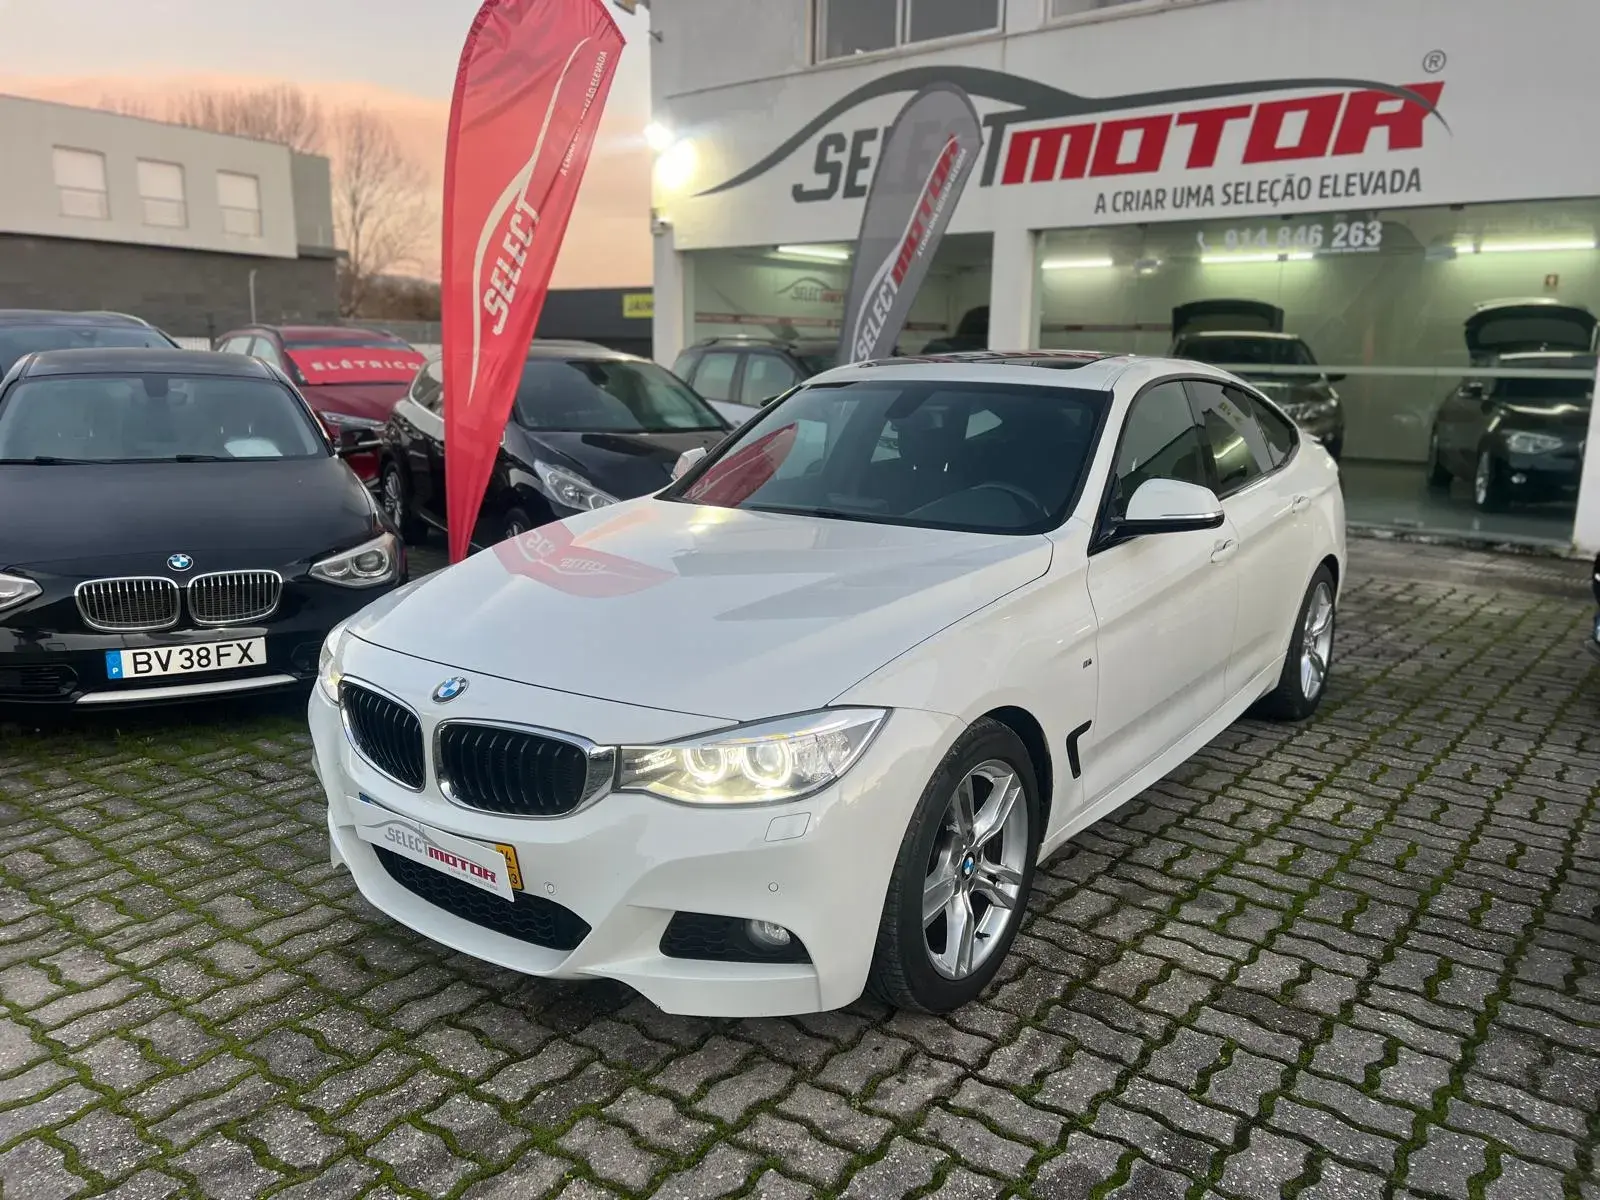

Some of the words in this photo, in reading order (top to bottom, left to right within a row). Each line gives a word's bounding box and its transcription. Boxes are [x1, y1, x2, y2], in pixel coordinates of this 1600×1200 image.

[1094, 192, 1107, 214] A
[1112, 187, 1166, 213] CRIAR
[1172, 184, 1215, 209] UMA
[1221, 173, 1312, 207] SELEÇÃO
[1319, 167, 1422, 199] ELEVADA
[1330, 220, 1383, 248] 263
[483, 191, 540, 336] SELECT
